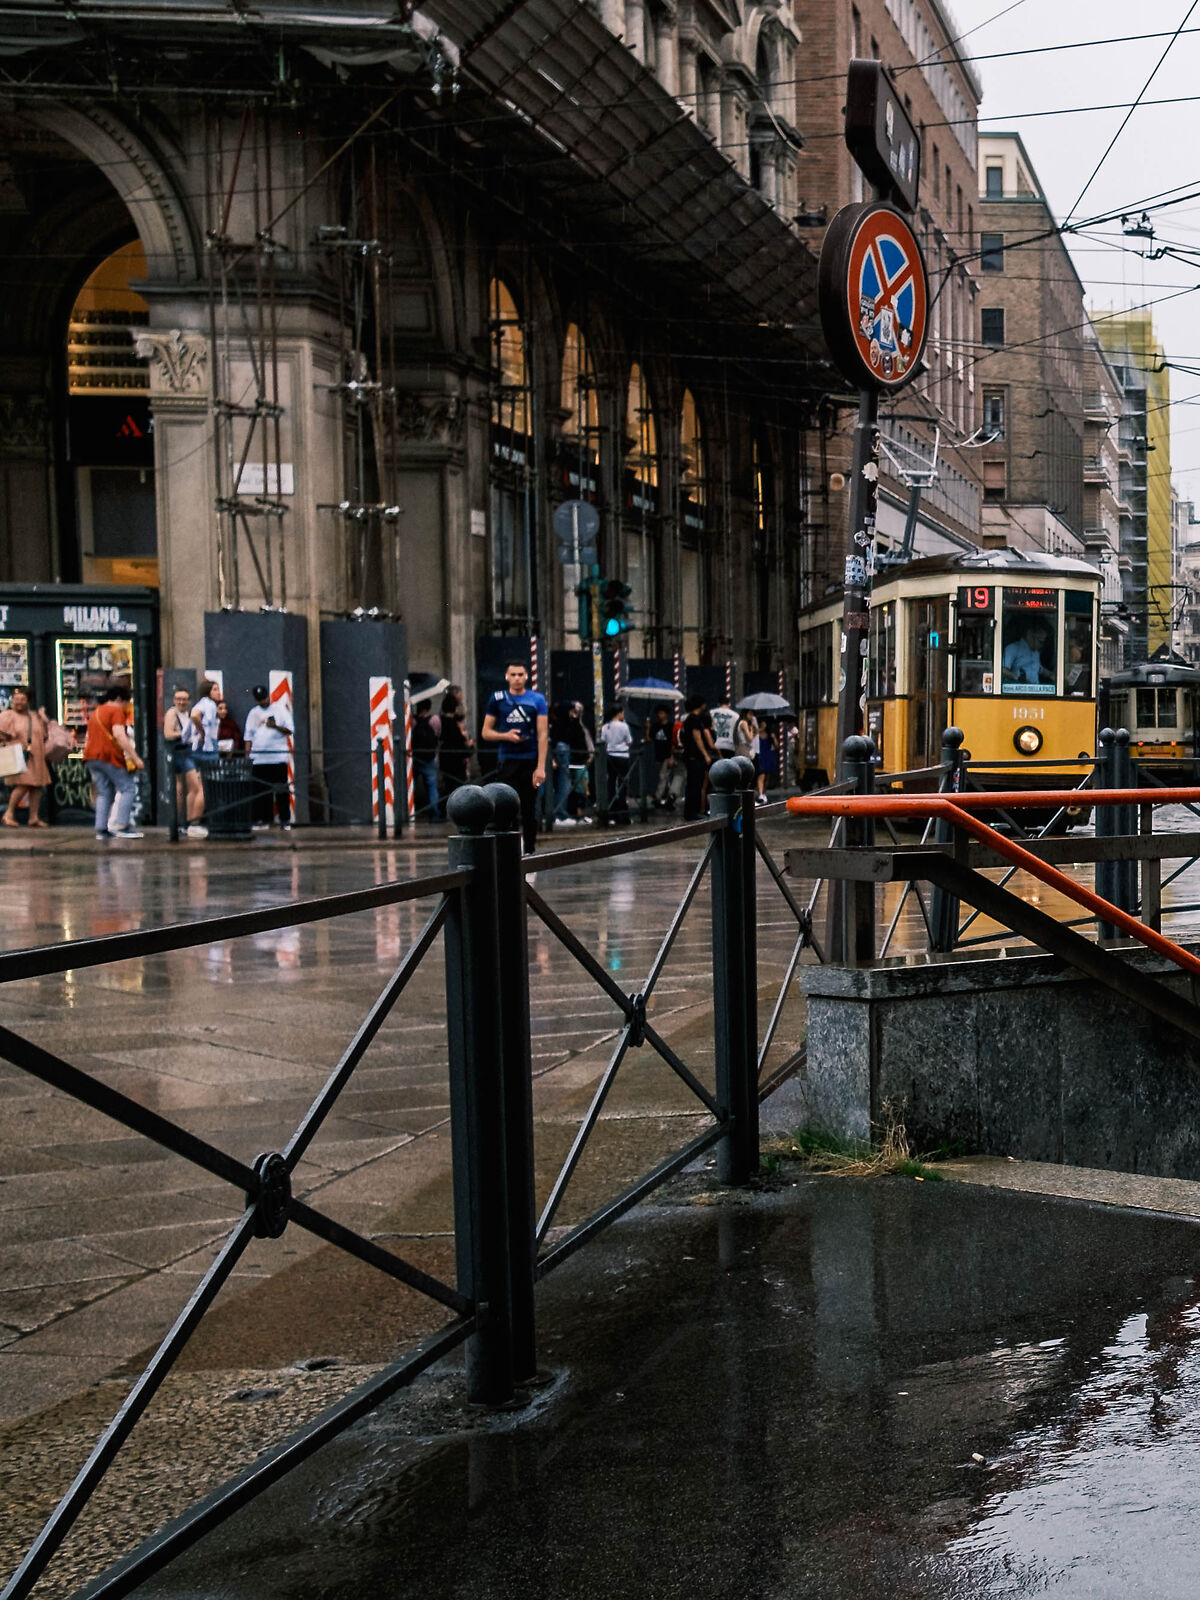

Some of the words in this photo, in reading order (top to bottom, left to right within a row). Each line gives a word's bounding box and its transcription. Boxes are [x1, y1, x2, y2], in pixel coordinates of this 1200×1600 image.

[966, 587, 989, 609] 19
[64, 606, 120, 623] MILANO
[1013, 706, 1045, 720] 1951
